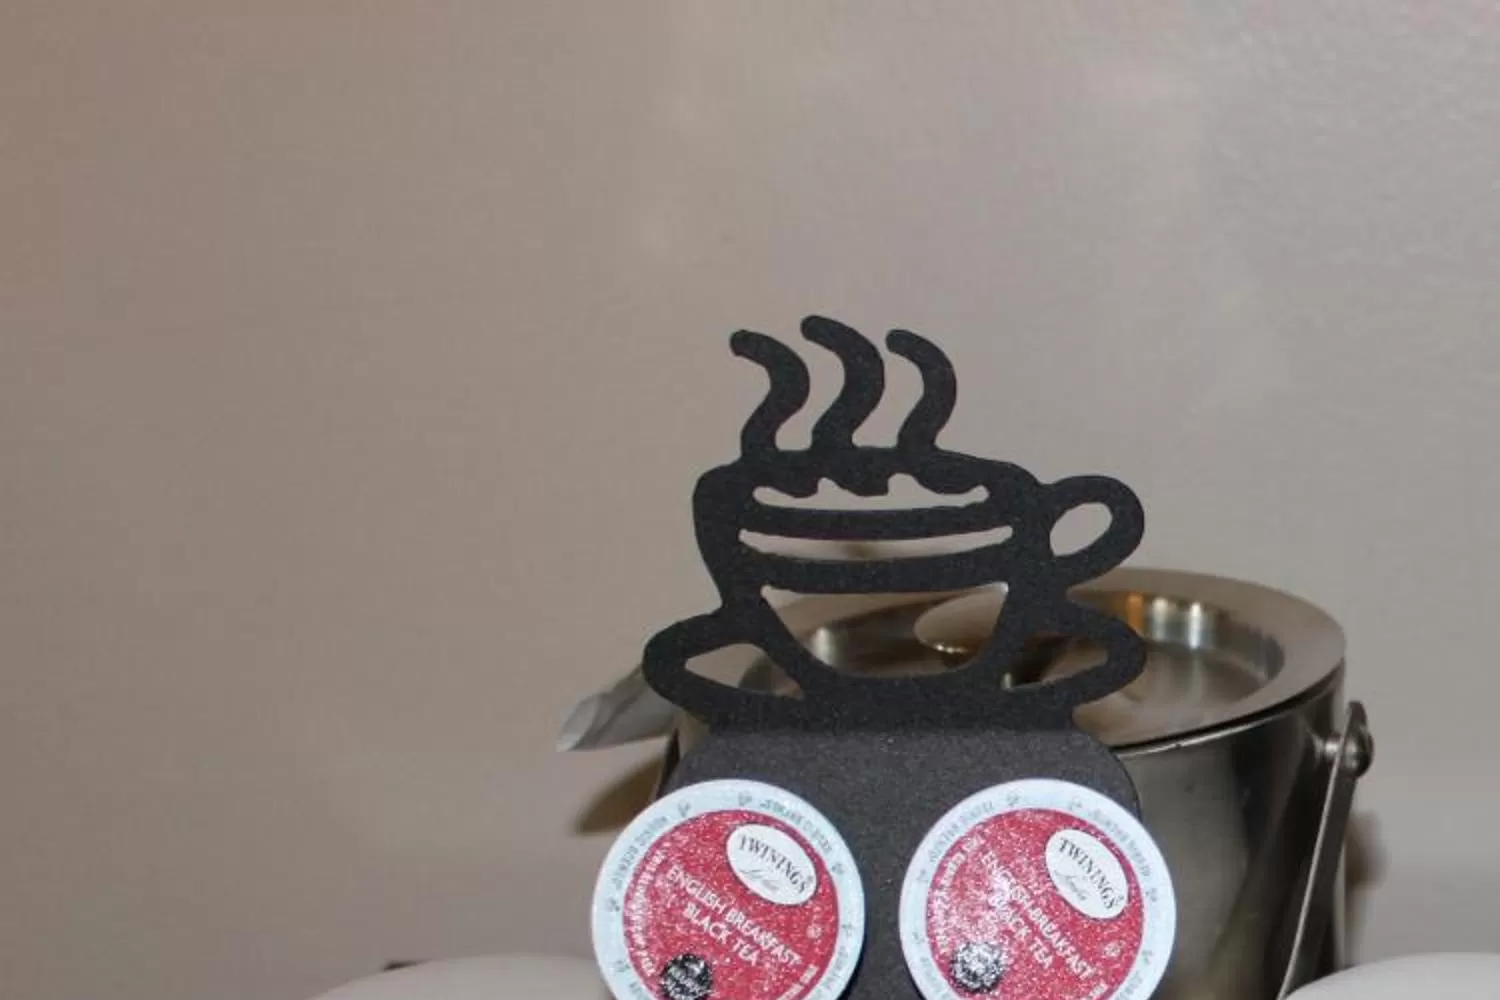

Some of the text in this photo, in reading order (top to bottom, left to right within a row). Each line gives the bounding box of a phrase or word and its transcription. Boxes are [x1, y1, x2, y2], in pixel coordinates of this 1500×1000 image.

[738, 834, 807, 894] TWININGS
[1058, 838, 1117, 909] TWININGS
[666, 865, 726, 914] ENGLISH
[724, 907, 801, 965] BREAKFAST
[684, 904, 759, 966] BLACK TEA
[1030, 904, 1096, 980] BREAKFAST
[1029, 936, 1054, 969] TEA
